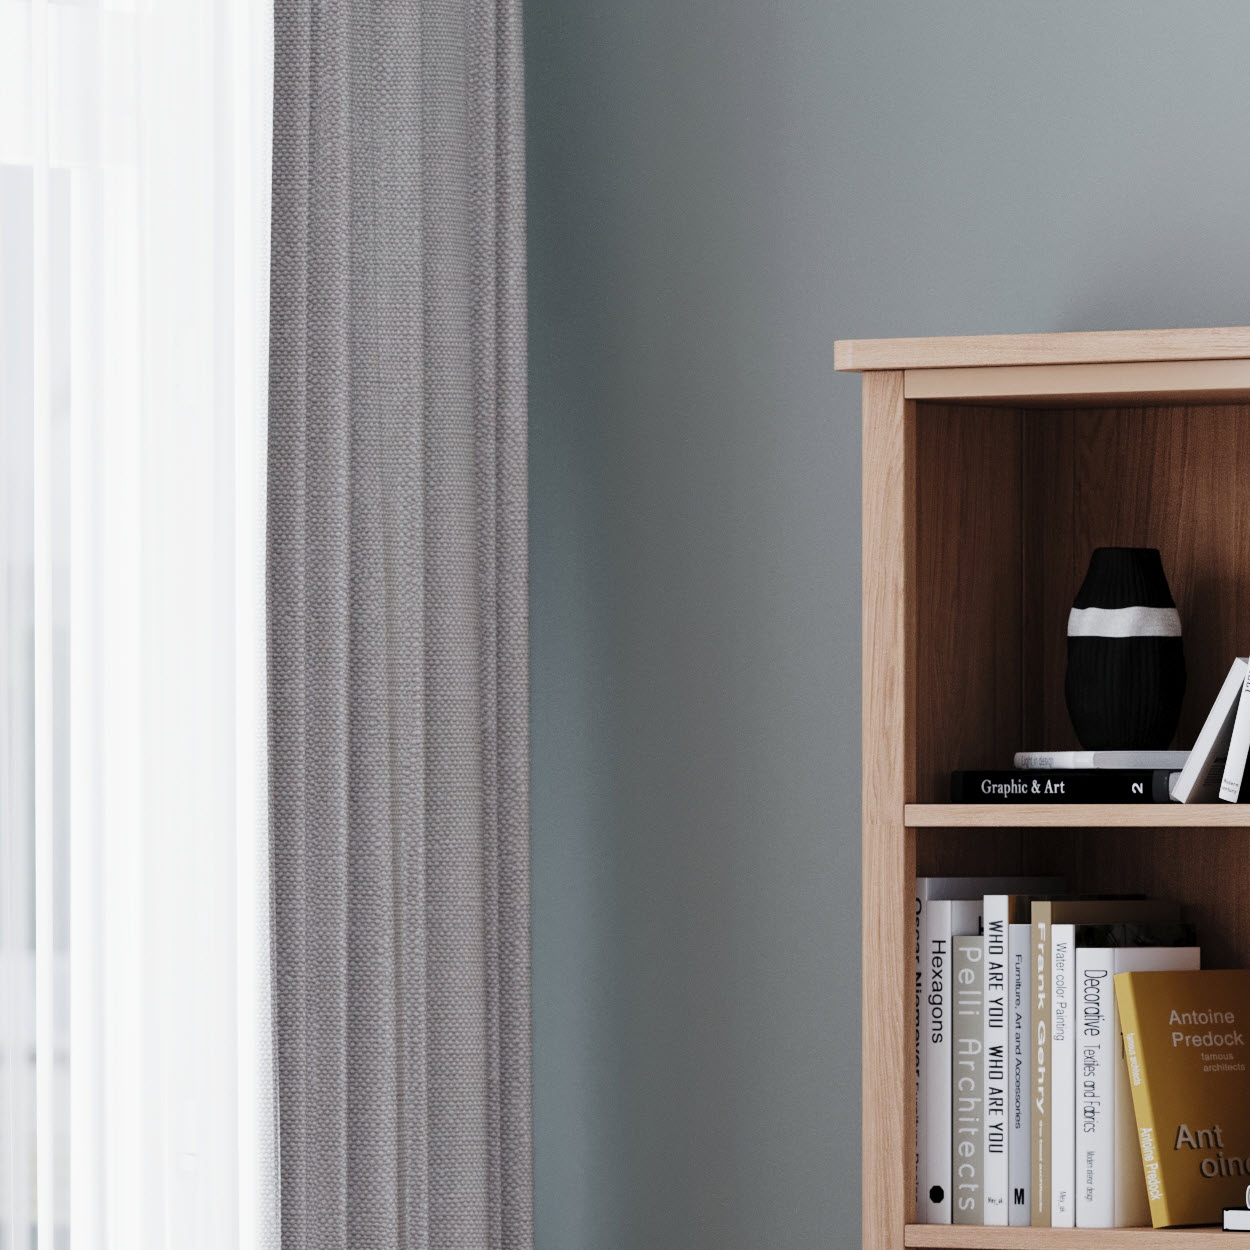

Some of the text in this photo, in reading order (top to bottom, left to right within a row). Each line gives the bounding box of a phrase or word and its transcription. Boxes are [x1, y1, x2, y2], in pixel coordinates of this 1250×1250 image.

[981, 779, 1065, 798] Graphic & Art
[929, 940, 946, 1044] Hexagons
[1037, 922, 1046, 1010] Frank
[1053, 942, 1068, 1041] Water color Painting
[988, 920, 1003, 1153] WHO ARE YOU WHO ARE YOU
[1014, 954, 1023, 1129] Furniture, Art and Accessories
[1084, 969, 1108, 1133] Decorative Textiles and Fabrics
[1169, 1009, 1235, 1026] Antoine
[1171, 1031, 1244, 1048] Predock
[958, 947, 983, 1211] Pelli Architects
[1036, 1020, 1046, 1115] Gehry
[1126, 1032, 1142, 1087] famous architects
[1201, 1052, 1234, 1061] famous
[1203, 1062, 1245, 1072] architects
[1140, 1127, 1164, 1201] Antoine Predock
[1174, 1124, 1225, 1150] Ant
[1014, 1188, 1025, 1205] M
